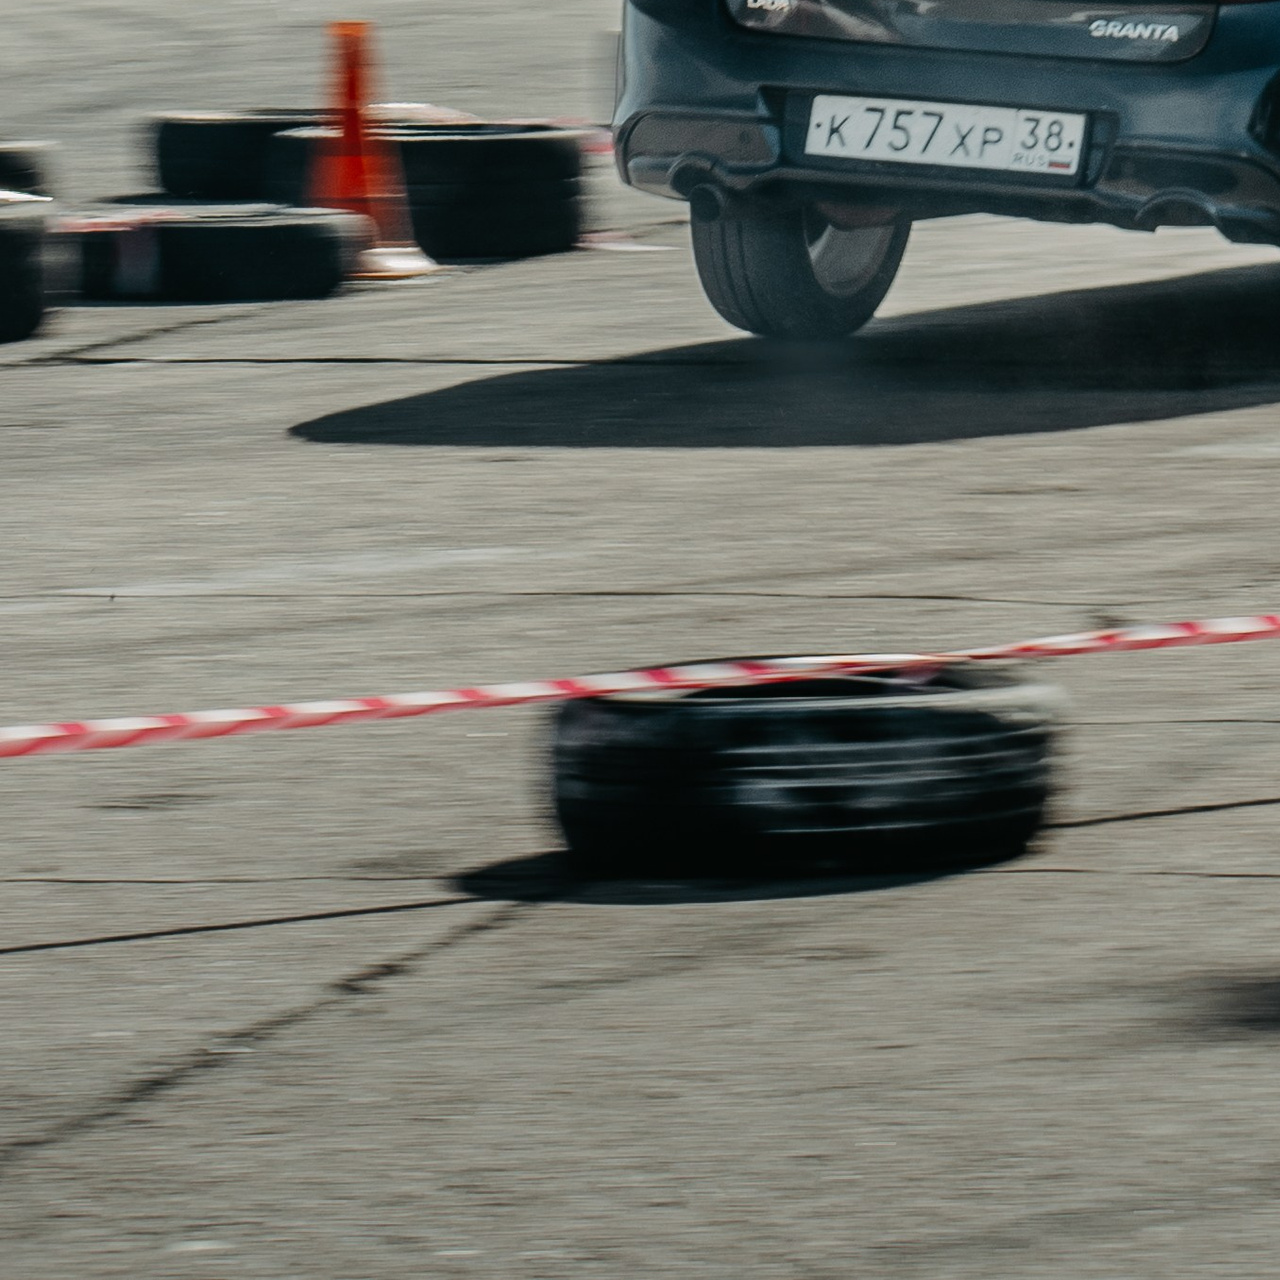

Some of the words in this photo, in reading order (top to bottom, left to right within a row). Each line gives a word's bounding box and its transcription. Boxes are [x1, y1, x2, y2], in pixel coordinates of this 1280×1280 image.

[1088, 19, 1179, 42] GRANTA
[1020, 117, 1065, 153] 38
[1012, 151, 1047, 167] RUS
